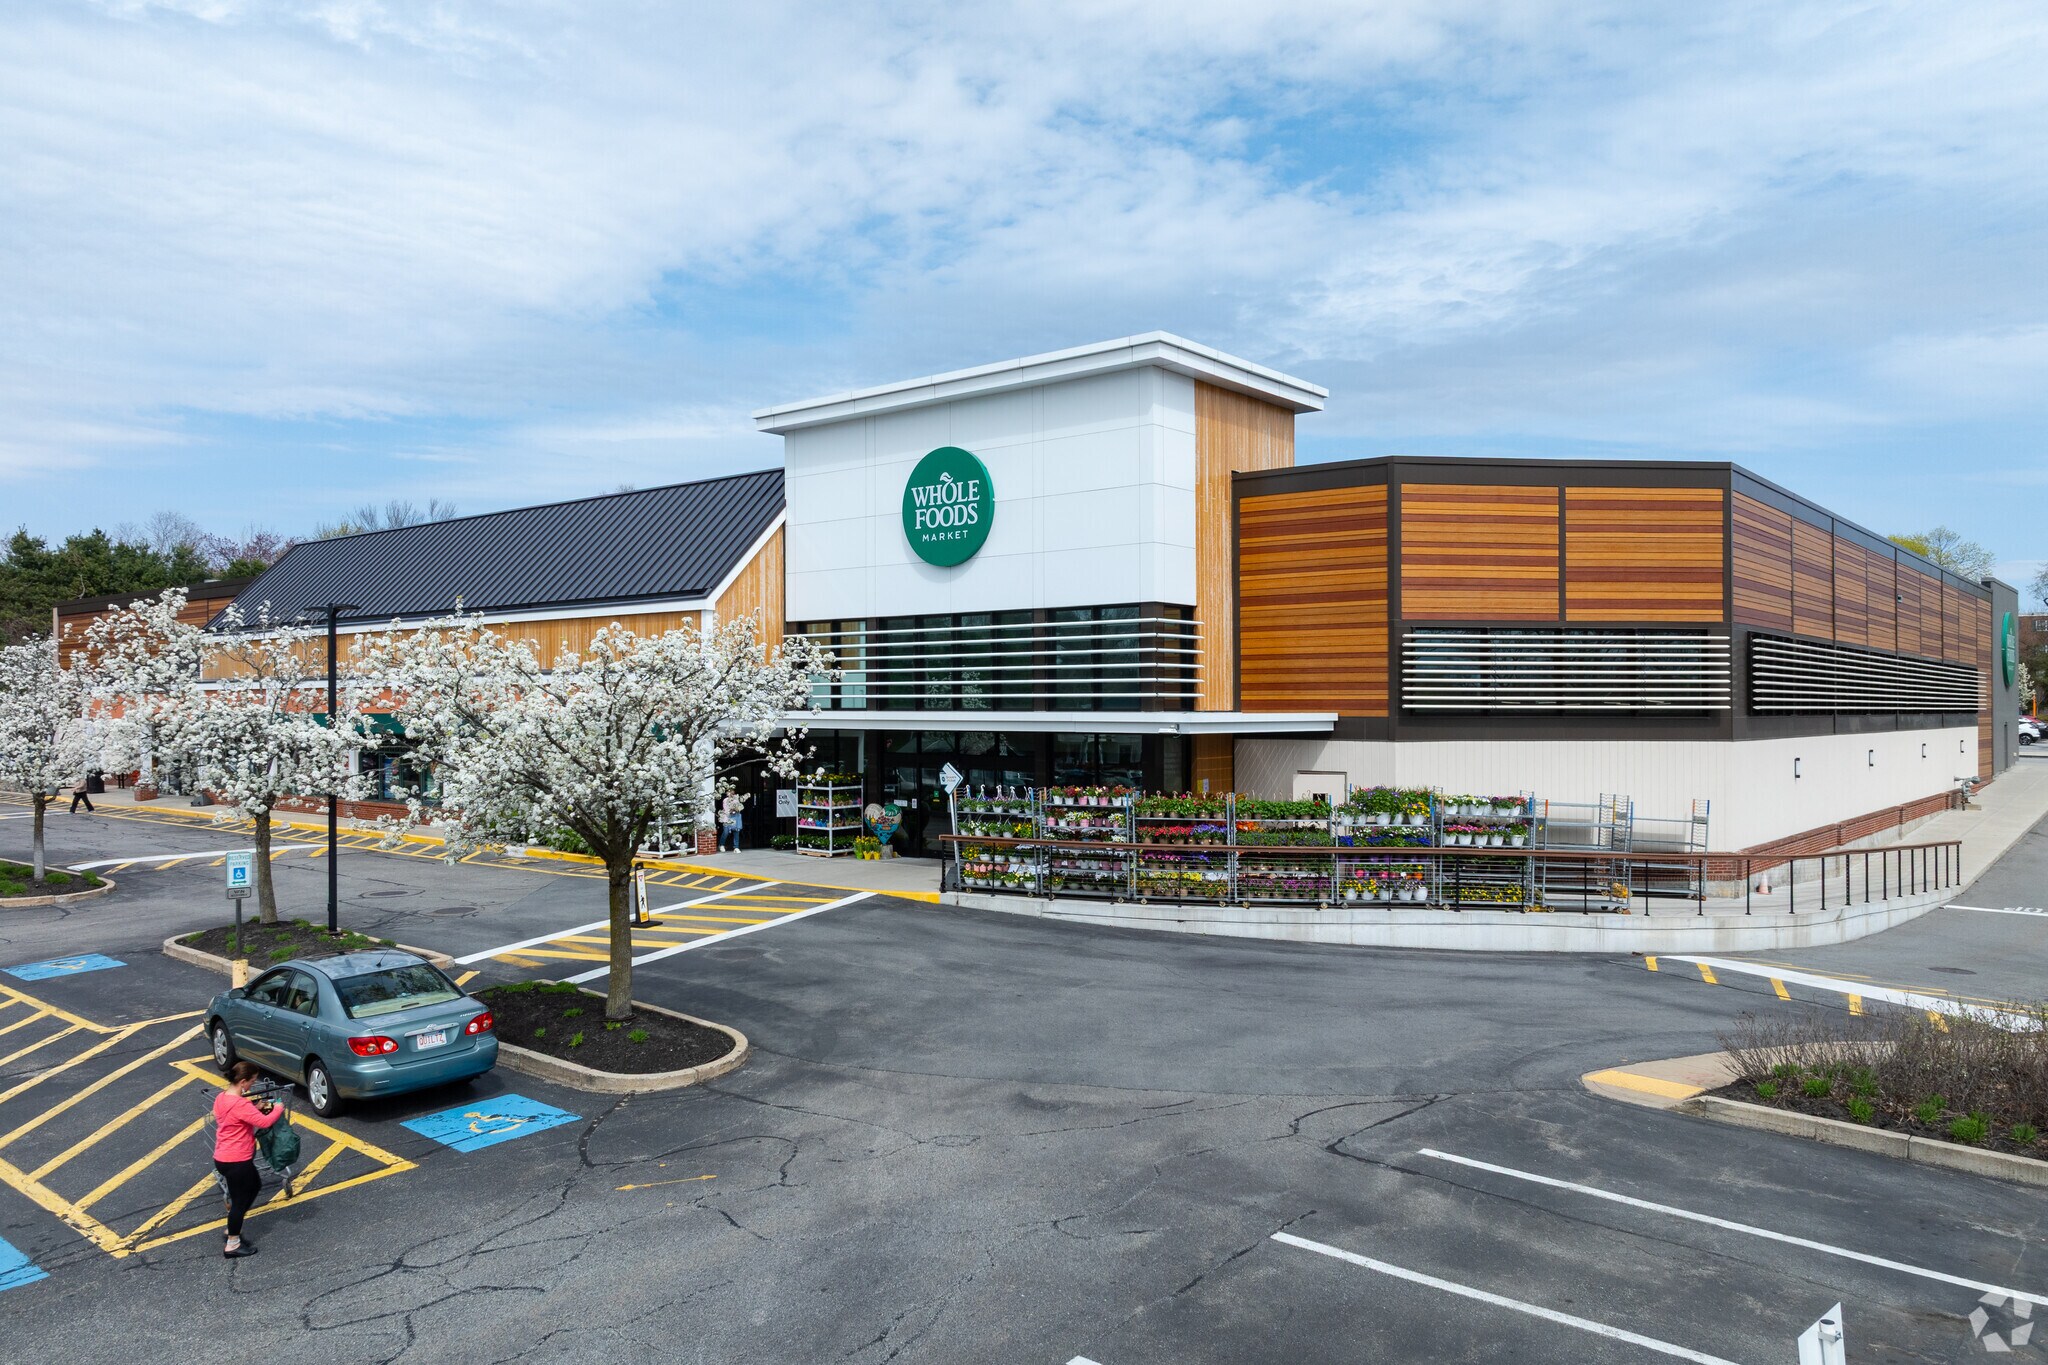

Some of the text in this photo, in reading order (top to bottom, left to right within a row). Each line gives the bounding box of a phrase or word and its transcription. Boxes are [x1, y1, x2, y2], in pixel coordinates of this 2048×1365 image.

[911, 478, 980, 508] WHOLE
[915, 503, 978, 530] FOODS
[922, 530, 968, 542] MARKET
